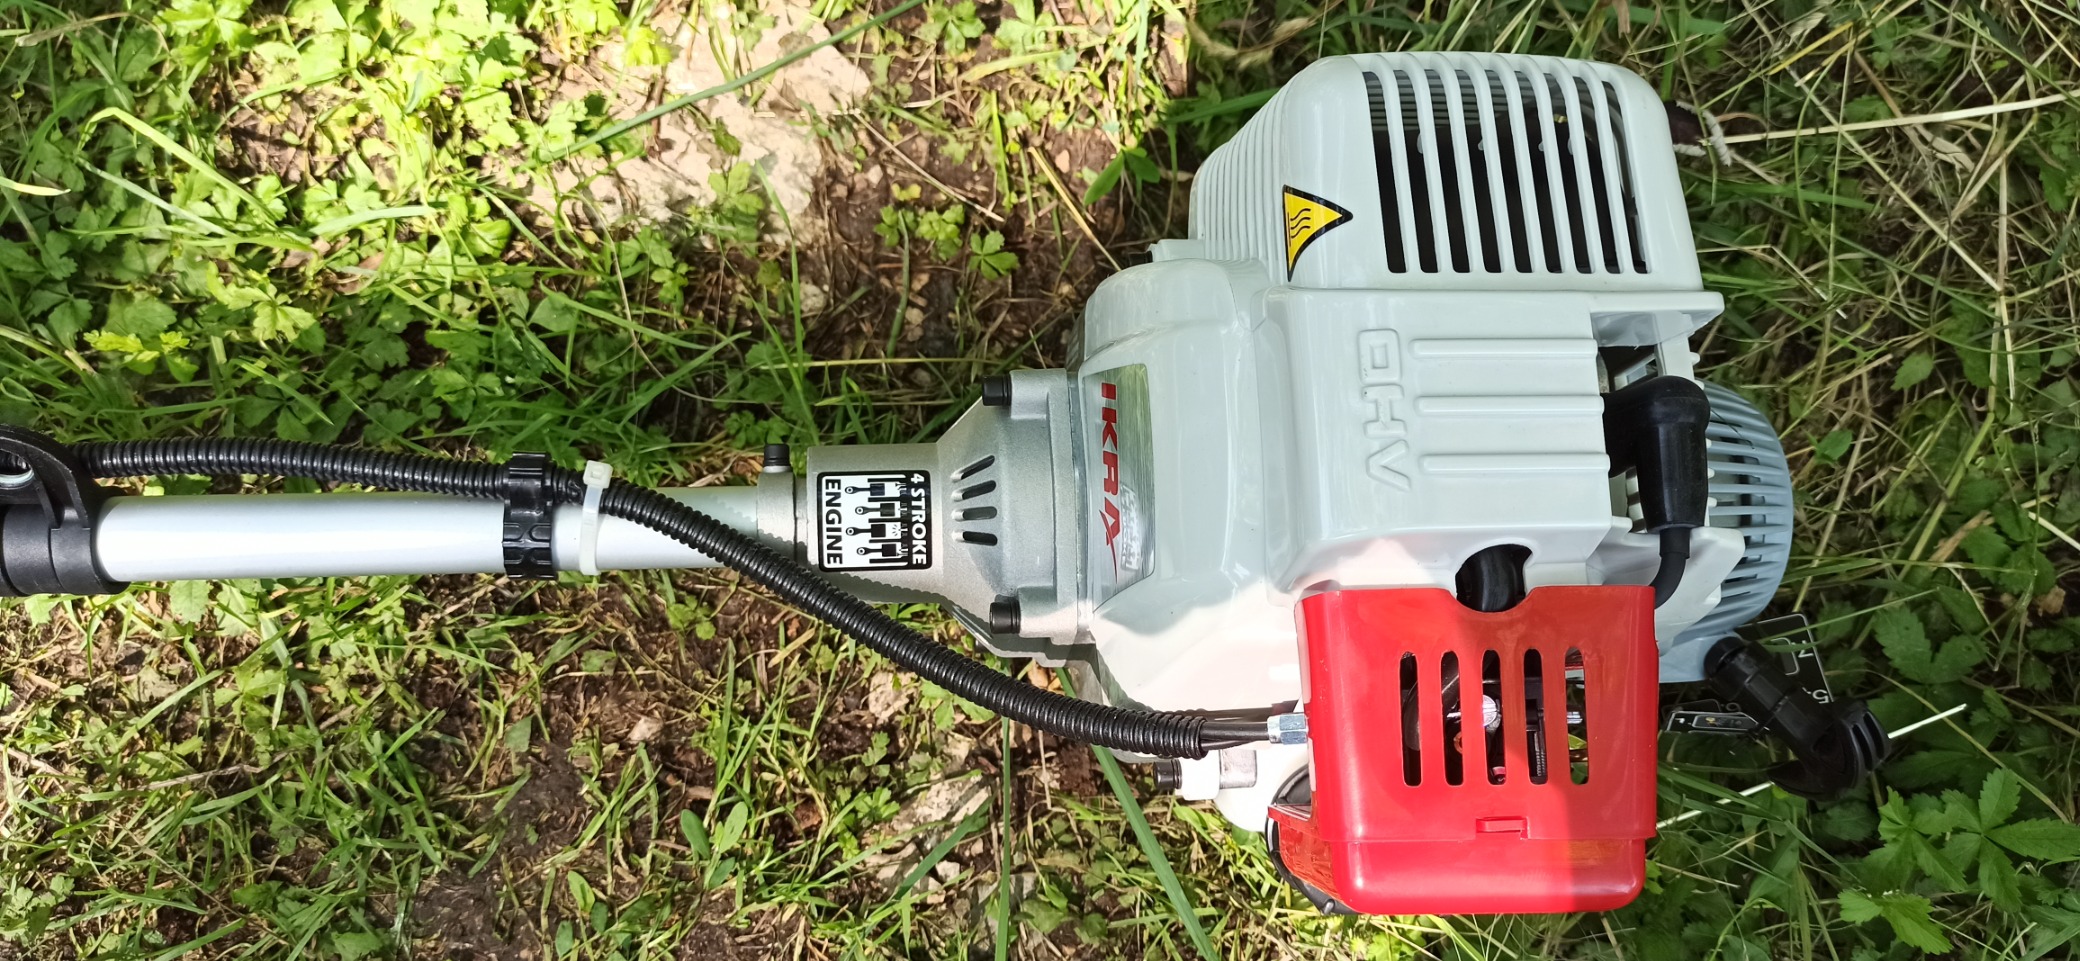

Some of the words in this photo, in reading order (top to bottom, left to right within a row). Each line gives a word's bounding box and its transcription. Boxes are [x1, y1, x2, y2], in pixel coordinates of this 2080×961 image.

[1357, 328, 1411, 492] OHV
[825, 478, 843, 565] ENGINE
[910, 473, 925, 484] 4
[1099, 382, 1121, 584] IKRA
[911, 487, 927, 565] STROKE
